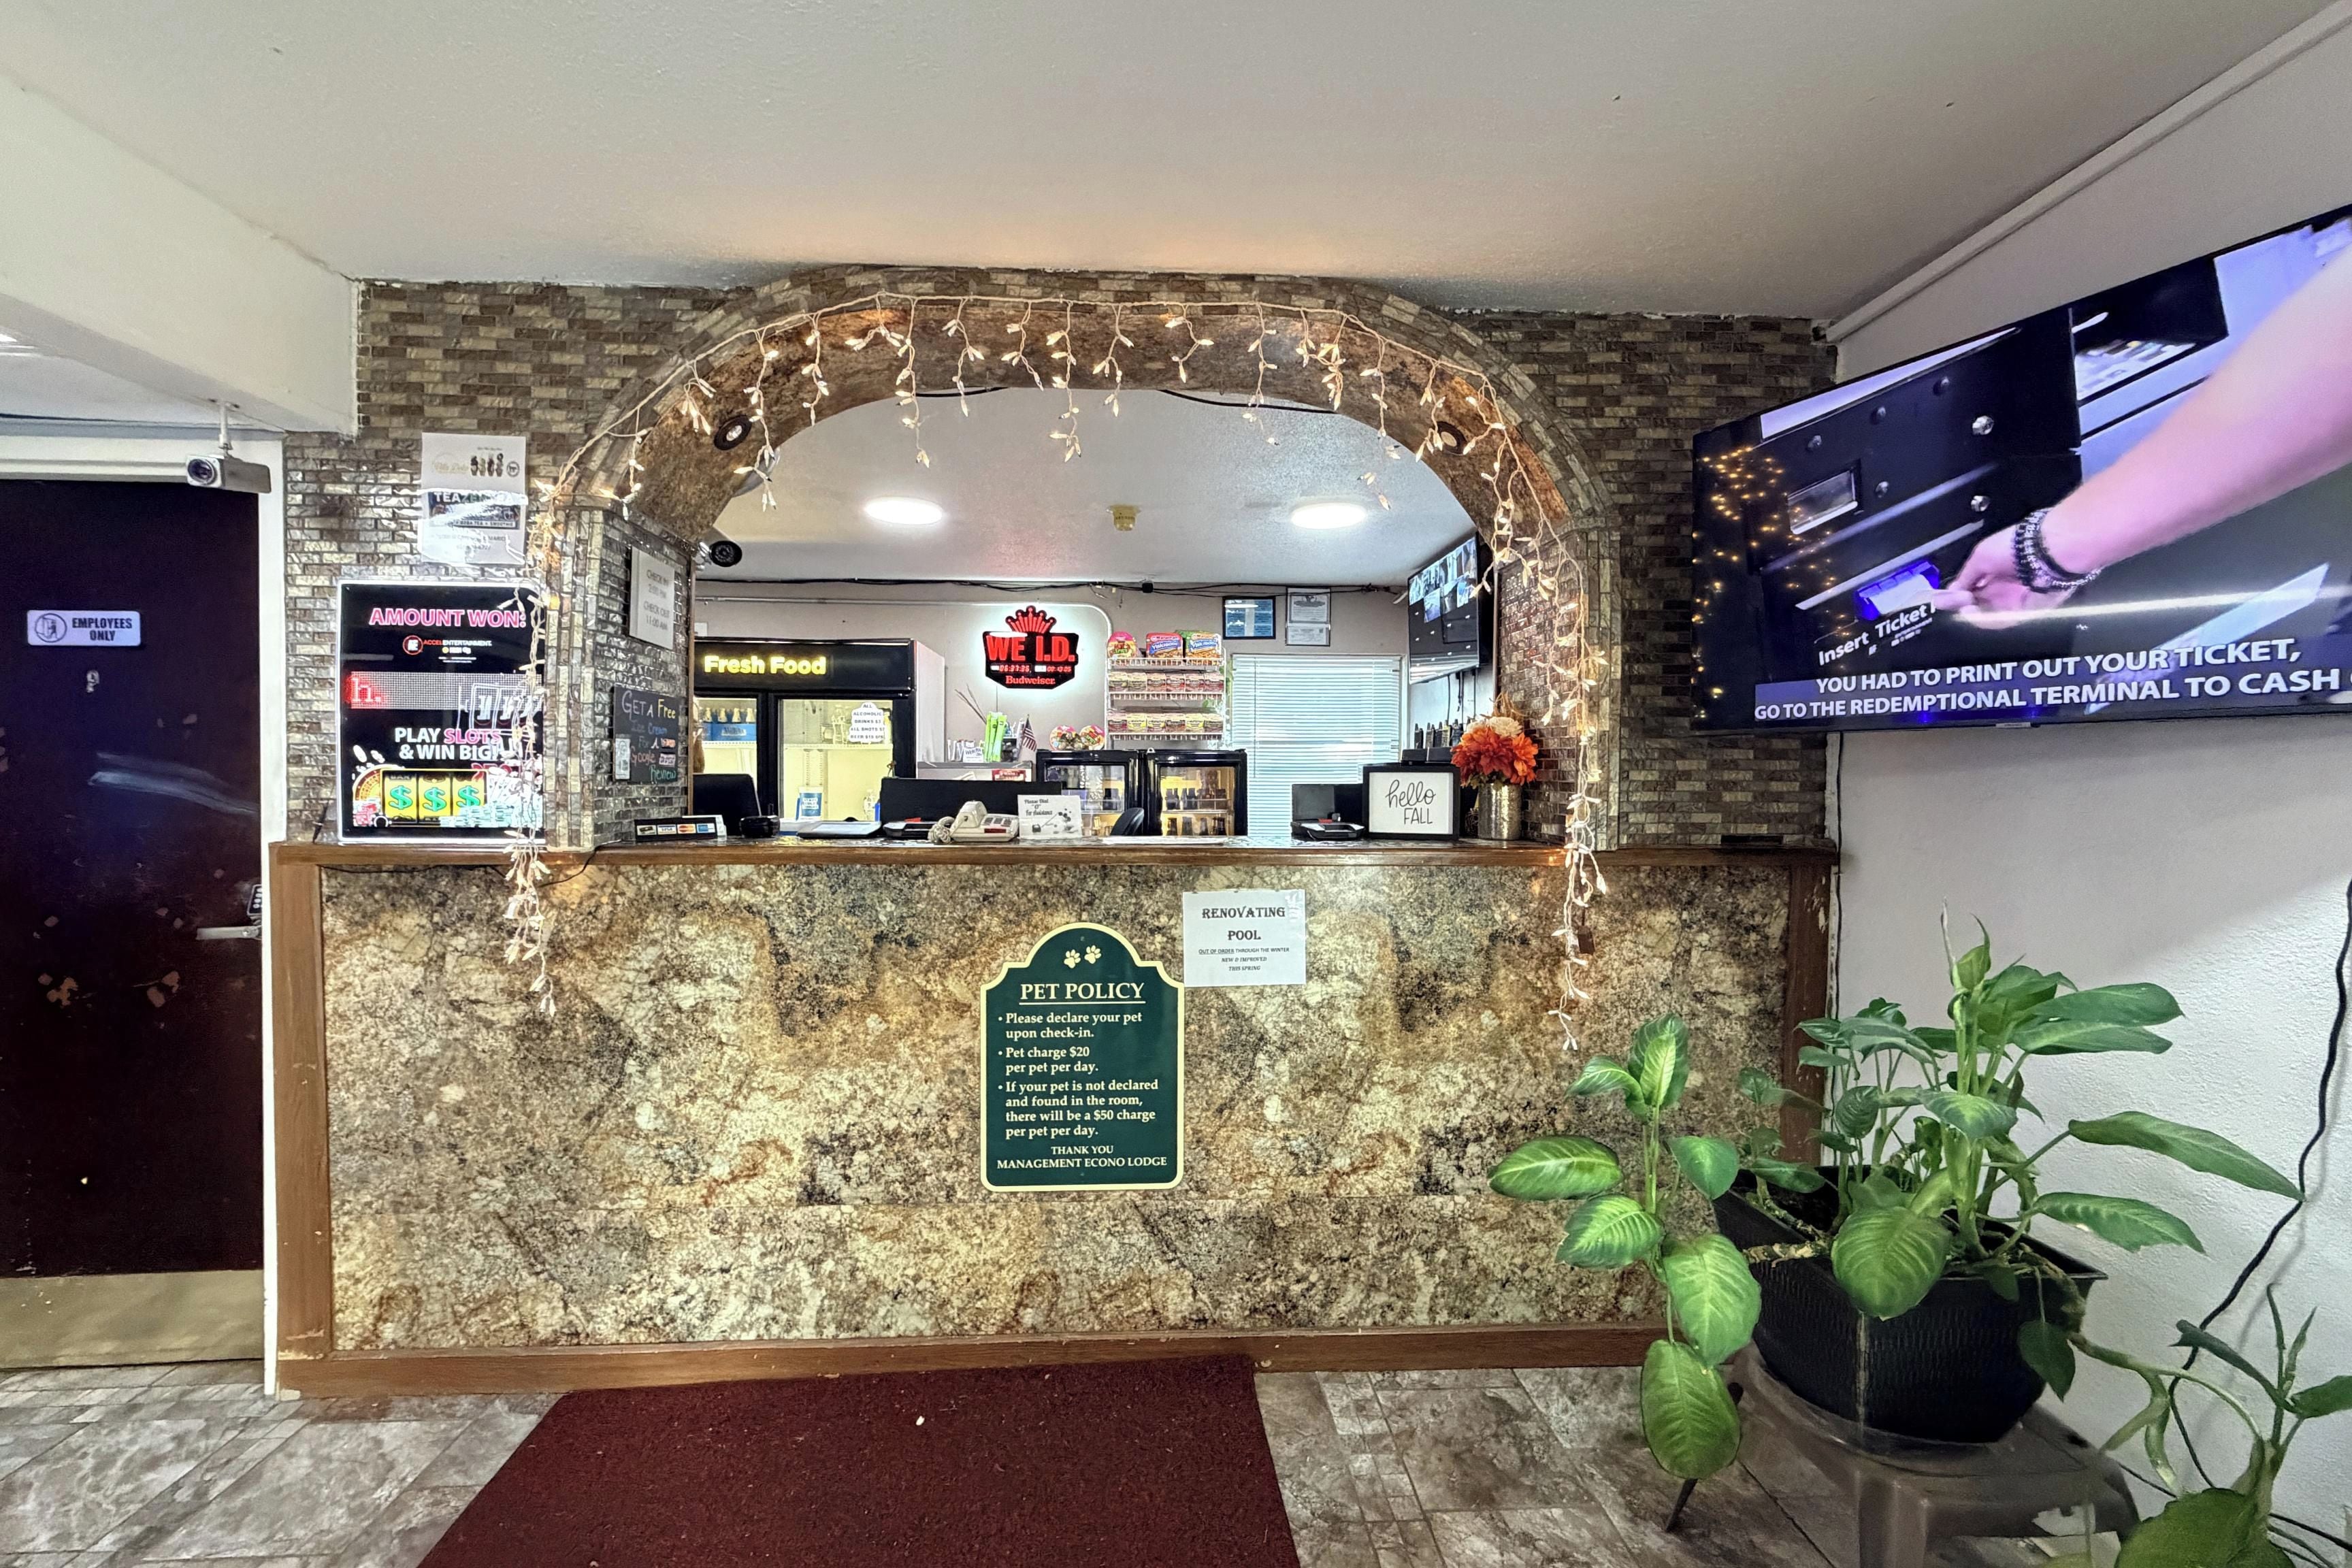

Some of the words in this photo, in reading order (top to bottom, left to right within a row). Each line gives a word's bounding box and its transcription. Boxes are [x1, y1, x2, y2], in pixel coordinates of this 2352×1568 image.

[71, 617, 132, 629] EMPLOYEES
[369, 608, 465, 627] AMOUNT
[468, 609, 527, 628] WON:
[90, 630, 116, 641] ONLY
[1818, 632, 1869, 666] Insert
[1874, 604, 1927, 638] Ticket
[986, 635, 1026, 662] WE
[1035, 636, 1075, 662] I.D.
[704, 655, 766, 674] Fresh
[770, 655, 827, 675] Food
[1816, 678, 1857, 693] YOU
[1861, 672, 1907, 691] HAD
[1910, 668, 1941, 686] TO
[1946, 662, 2017, 685] PRINT
[2023, 657, 2081, 679] OUT
[2085, 649, 2170, 674] YOUR
[2174, 638, 2302, 669] TICKET,
[1754, 704, 1780, 720] GO
[1783, 702, 1808, 718] TO
[1810, 700, 1846, 718] THE
[1850, 689, 2027, 716] REDEMPTIONAL
[2031, 680, 2180, 706] TERMINAL
[2185, 676, 2231, 698] TO
[2238, 668, 2340, 695] CASH
[622, 690, 647, 723] GET
[647, 704, 654, 719] A
[657, 698, 676, 719] Free
[395, 728, 441, 743] PLAY
[444, 728, 502, 745] SLOTS
[399, 745, 414, 760] &
[415, 745, 455, 760] WIN
[459, 745, 499, 761] BIG!
[631, 745, 657, 766] Google
[650, 764, 676, 784] Review
[1385, 779, 1436, 808] hello
[1404, 807, 1433, 824] FALL
[1202, 905, 1286, 919] RENOVATING
[1227, 930, 1262, 941] POOL
[1020, 983, 1060, 1000] PET
[1065, 982, 1145, 999] POLICY
[1005, 1013, 1043, 1024] Please
[1046, 1012, 1089, 1023] declare
[1092, 1014, 1120, 1026] your
[1123, 1013, 1143, 1025] pet
[1006, 1029, 1037, 1041] upon
[1040, 1027, 1094, 1039] check-in.
[1005, 1047, 1024, 1058] Pet
[1027, 1046, 1067, 1060] charge
[1069, 1046, 1090, 1057] $20
[1005, 1063, 1024, 1075] per
[1028, 1063, 1047, 1075] pet
[1050, 1063, 1070, 1075] per
[1073, 1061, 1098, 1075] day.
[1005, 1081, 1015, 1092] If
[1019, 1083, 1047, 1095] your
[1050, 1081, 1069, 1094] pet
[1072, 1080, 1083, 1091] is
[1085, 1081, 1105, 1090] not
[1108, 1079, 1158, 1090] declared
[1005, 1096, 1028, 1107] and
[1031, 1095, 1068, 1107] found
[1071, 1095, 1083, 1106] in
[1086, 1095, 1105, 1105] the
[1108, 1096, 1143, 1107] room,
[1005, 1111, 1036, 1122] there
[1040, 1110, 1063, 1121] will
[1066, 1110, 1081, 1120] be
[1083, 1112, 1091, 1120] a
[1094, 1109, 1113, 1121] $50
[1116, 1109, 1156, 1122] charge
[1005, 1127, 1024, 1139] per
[1028, 1126, 1047, 1139] pet
[1050, 1126, 1070, 1139] per
[1073, 1124, 1098, 1138] day.
[1050, 1146, 1089, 1155] THANK
[1091, 1145, 1114, 1154] YOU
[996, 1158, 1082, 1169] MANAGEMENT
[1084, 1157, 1125, 1167] ECONO
[1128, 1157, 1167, 1166] LODGE
